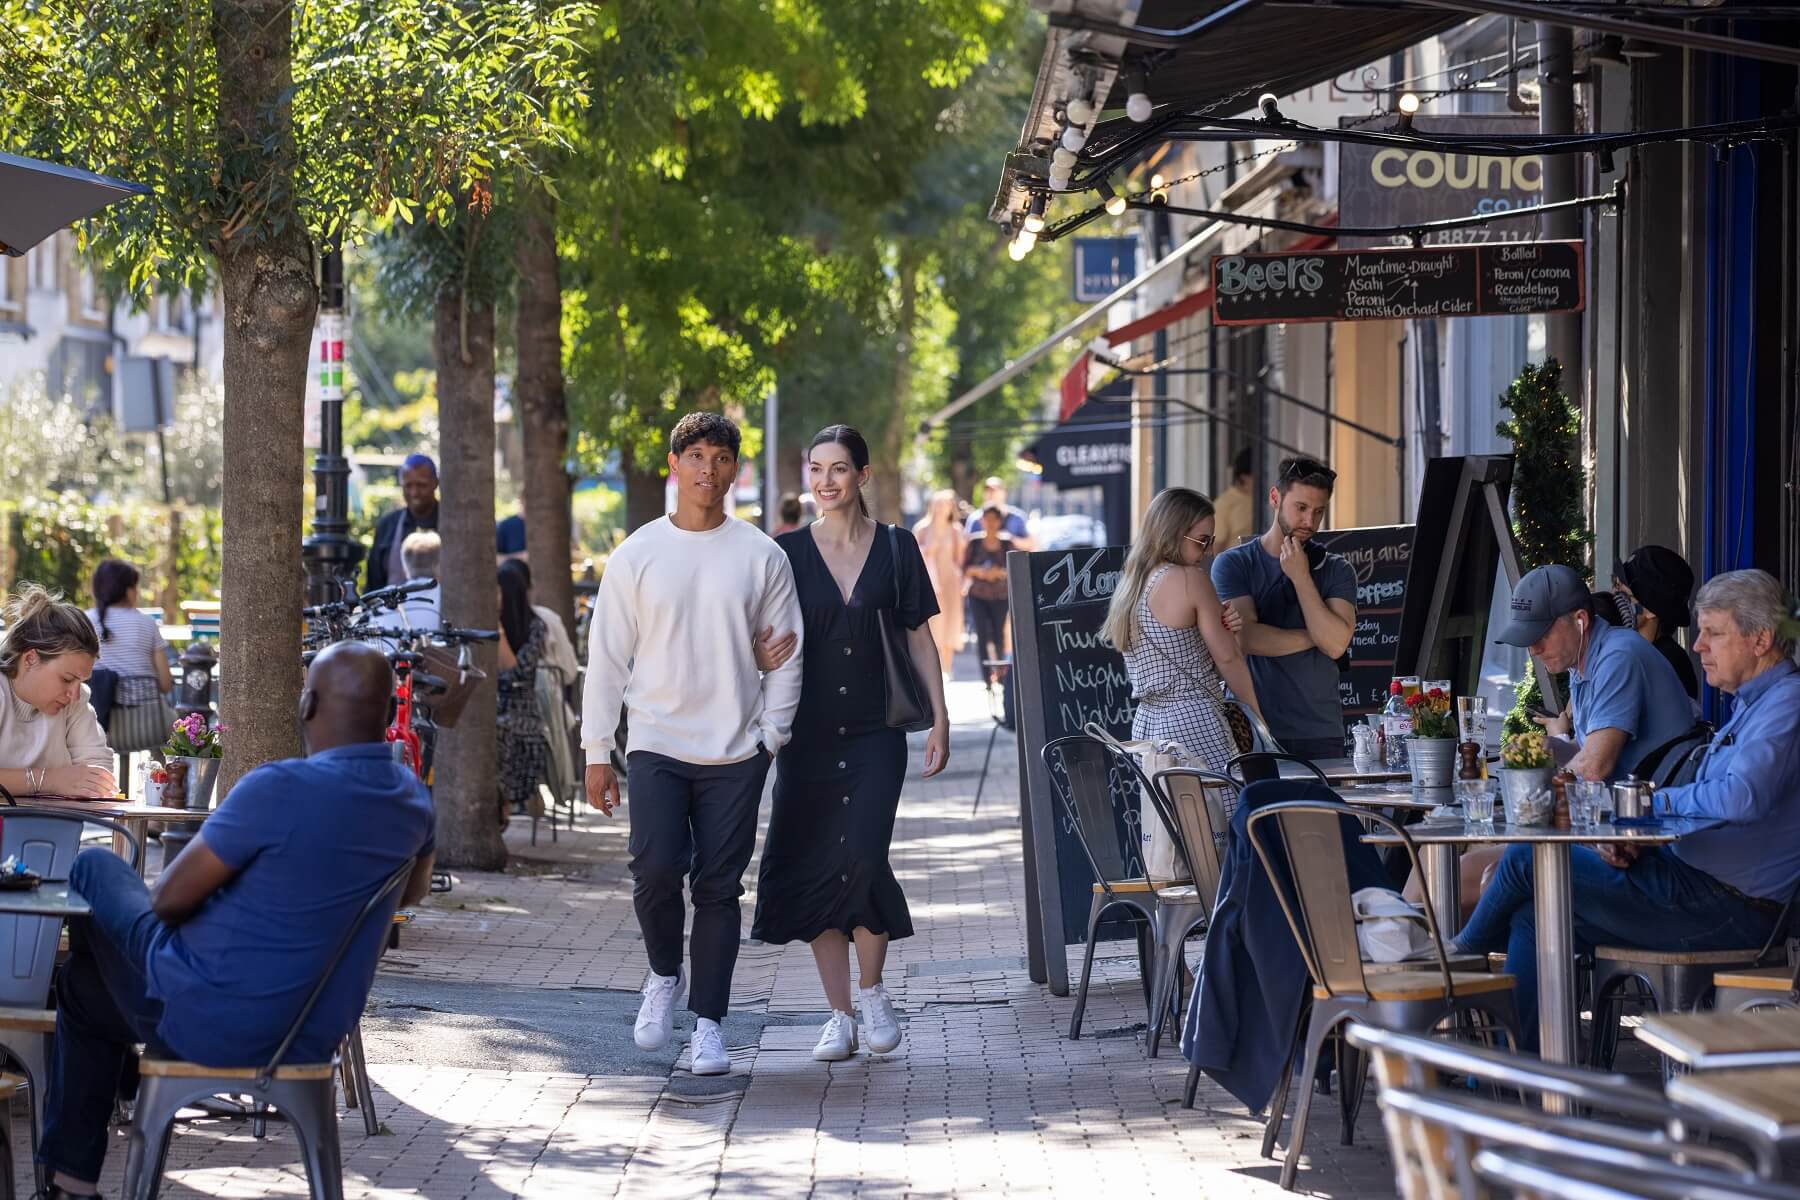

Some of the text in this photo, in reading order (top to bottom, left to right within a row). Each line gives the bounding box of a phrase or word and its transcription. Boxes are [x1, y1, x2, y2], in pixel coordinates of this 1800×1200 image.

[1438, 229, 1491, 244] 8877
[1216, 256, 1325, 295] Beers
[1345, 252, 1454, 279] Meantime Draught
[1349, 276, 1383, 291] Asahi
[1346, 291, 1385, 306] Peroni
[1442, 297, 1473, 313] Cider
[1343, 543, 1410, 583] nnigans
[1055, 660, 1130, 706] Neigh
